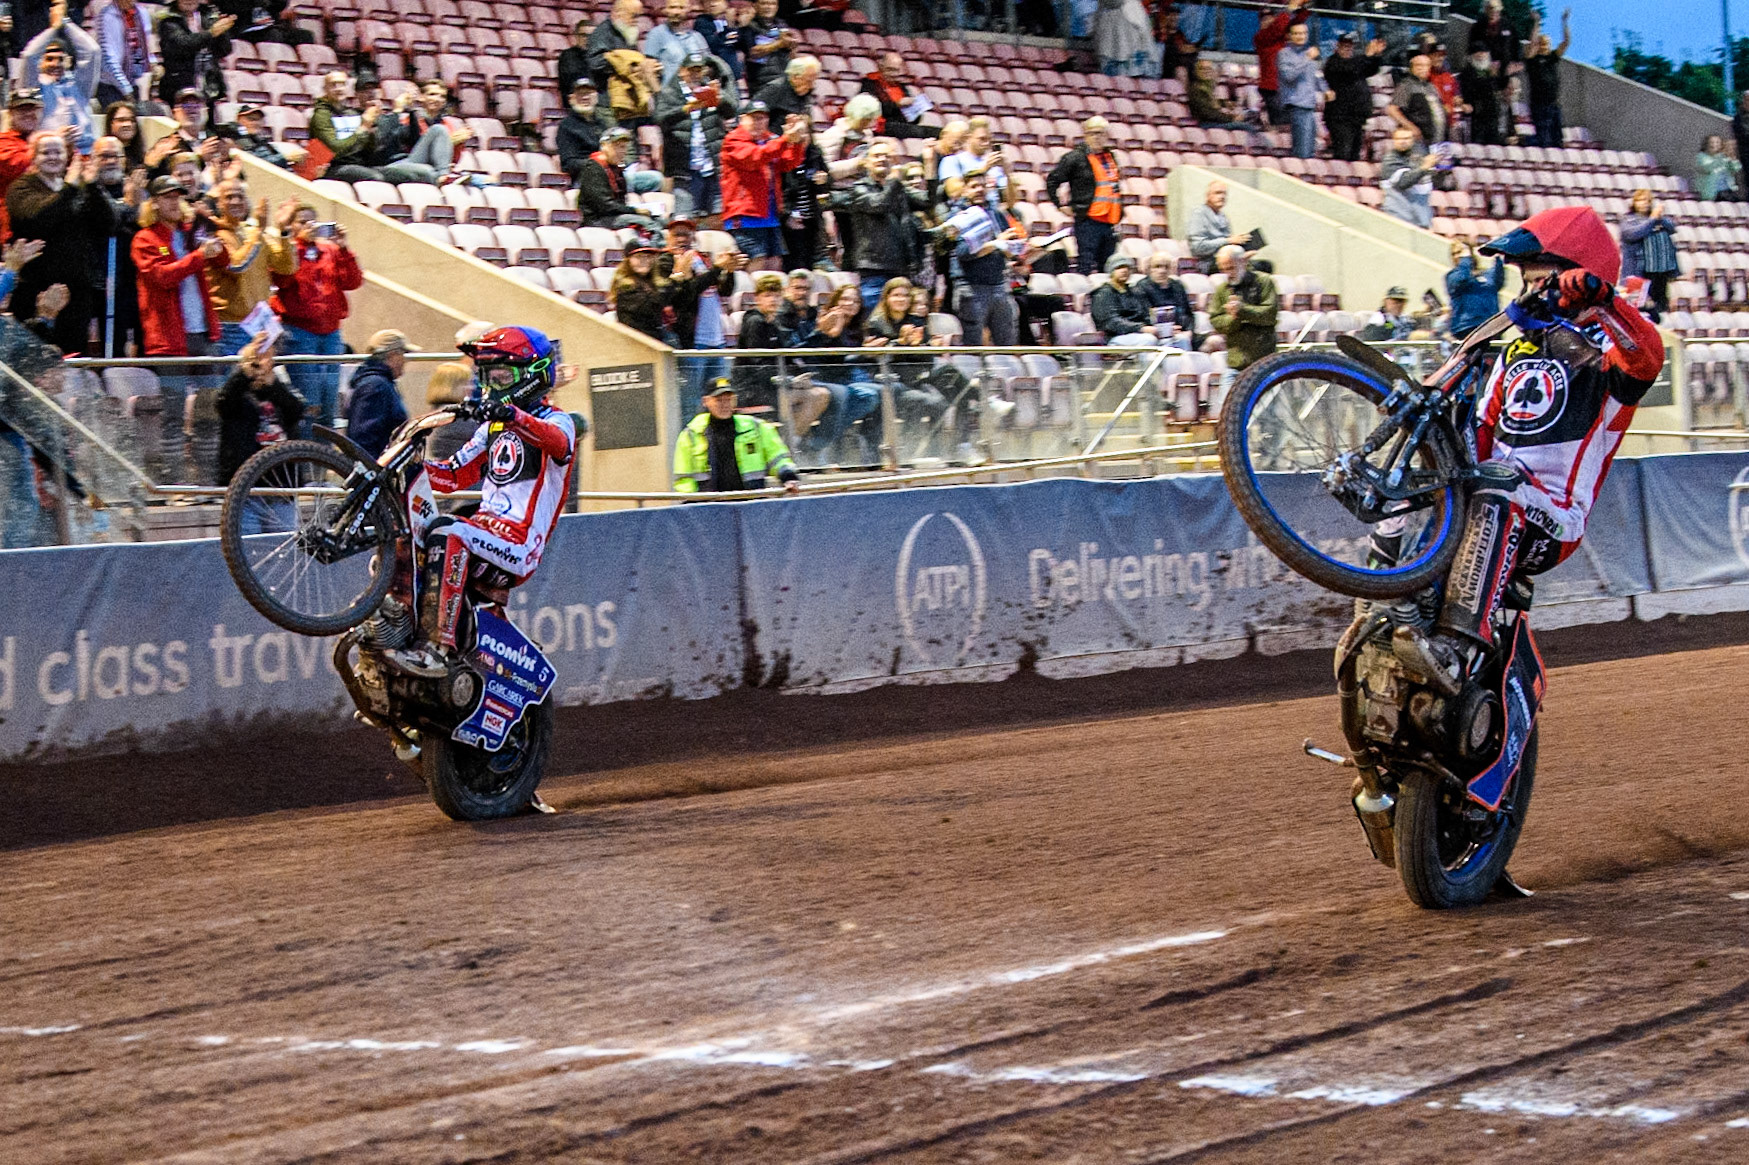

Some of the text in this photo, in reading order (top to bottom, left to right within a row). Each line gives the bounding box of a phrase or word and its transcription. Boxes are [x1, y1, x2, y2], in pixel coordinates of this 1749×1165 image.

[912, 563, 970, 613] ATPI
[1028, 539, 1211, 612] Delivering
[37, 629, 190, 706] class
[208, 623, 338, 688] trav
[538, 666, 551, 683] 5
